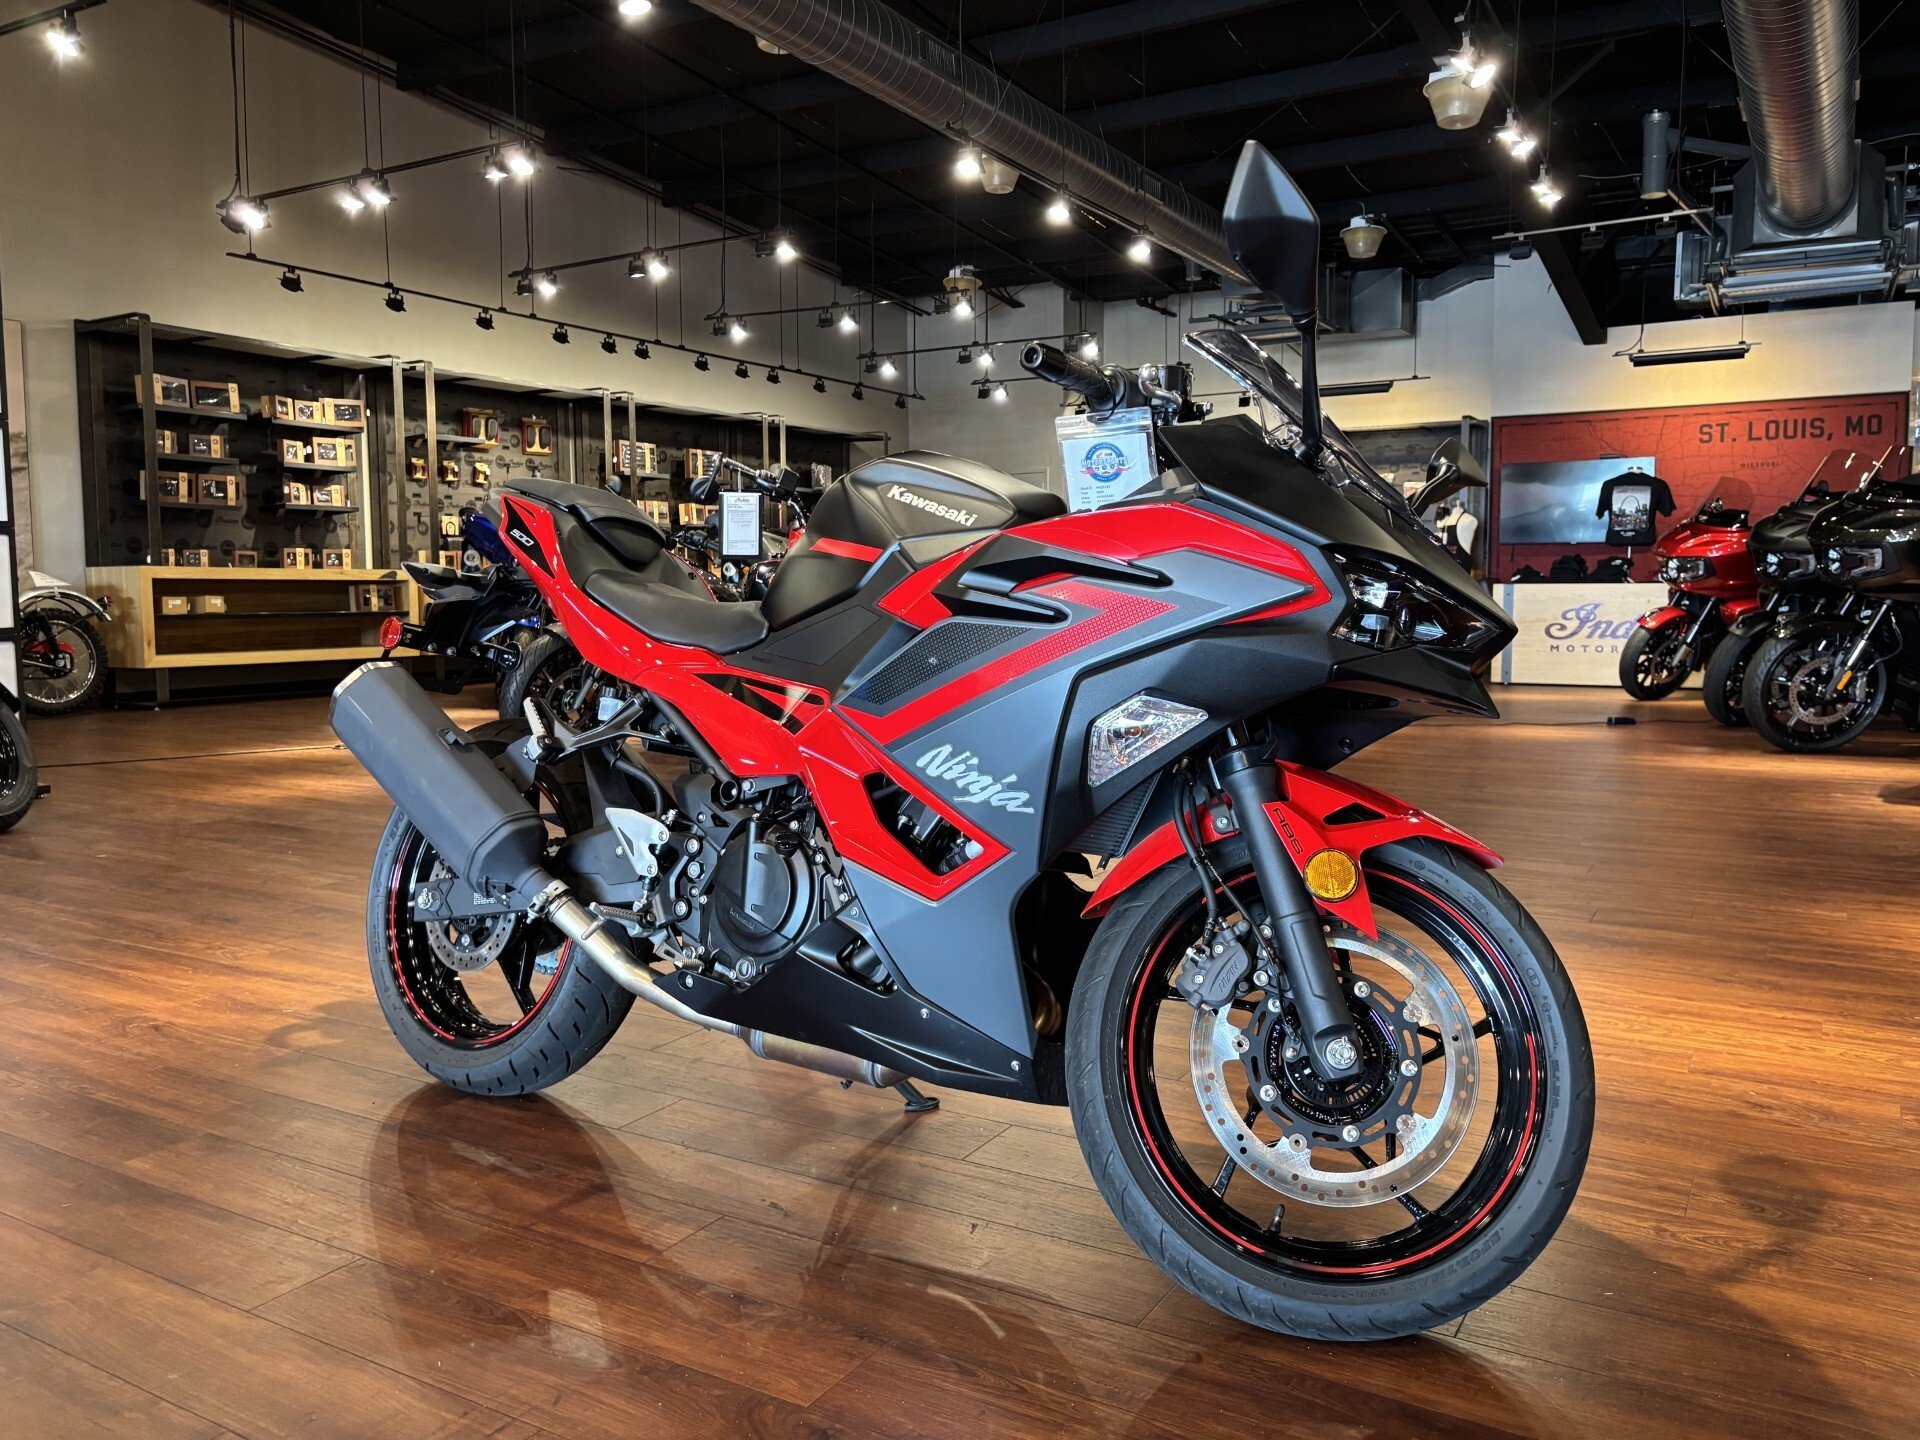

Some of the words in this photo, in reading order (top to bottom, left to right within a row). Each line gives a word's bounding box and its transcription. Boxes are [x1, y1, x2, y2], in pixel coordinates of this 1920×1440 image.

[1698, 422, 1737, 444] ST.
[1748, 417, 1834, 442] LOUIS,
[1845, 413, 1883, 437] MO
[886, 483, 978, 529] Kawasaki
[509, 528, 535, 547] 500
[915, 743, 1035, 814] Ninja
[1272, 807, 1304, 855] ABS
